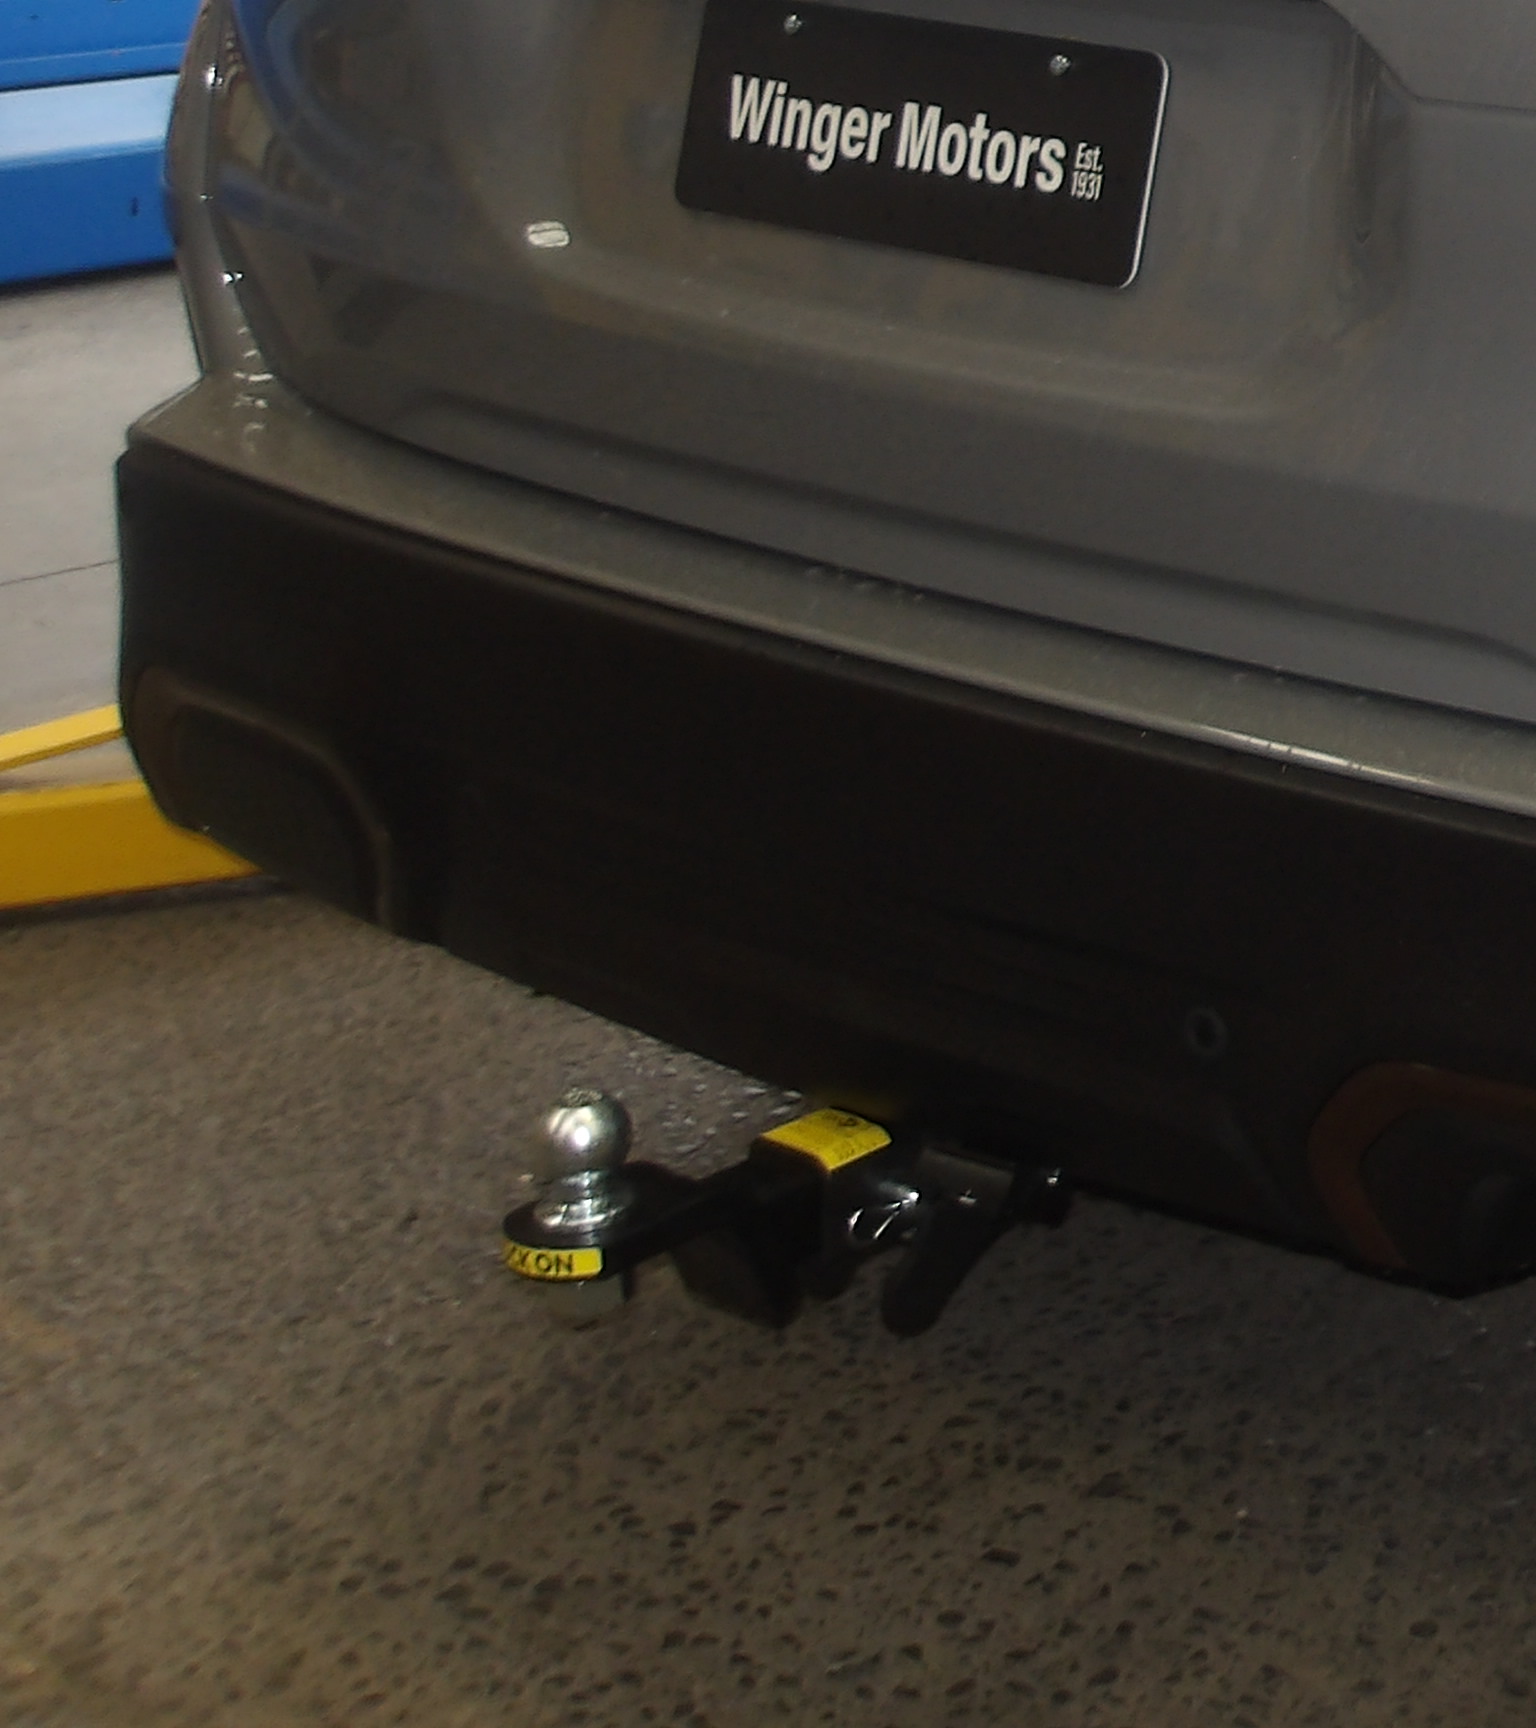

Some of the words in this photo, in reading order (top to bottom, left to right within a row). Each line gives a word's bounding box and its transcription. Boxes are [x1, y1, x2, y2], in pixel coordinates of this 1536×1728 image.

[728, 73, 892, 172] Winger
[895, 101, 1066, 194] Motors
[1074, 142, 1104, 172] Est.
[1071, 170, 1103, 201] 1931
